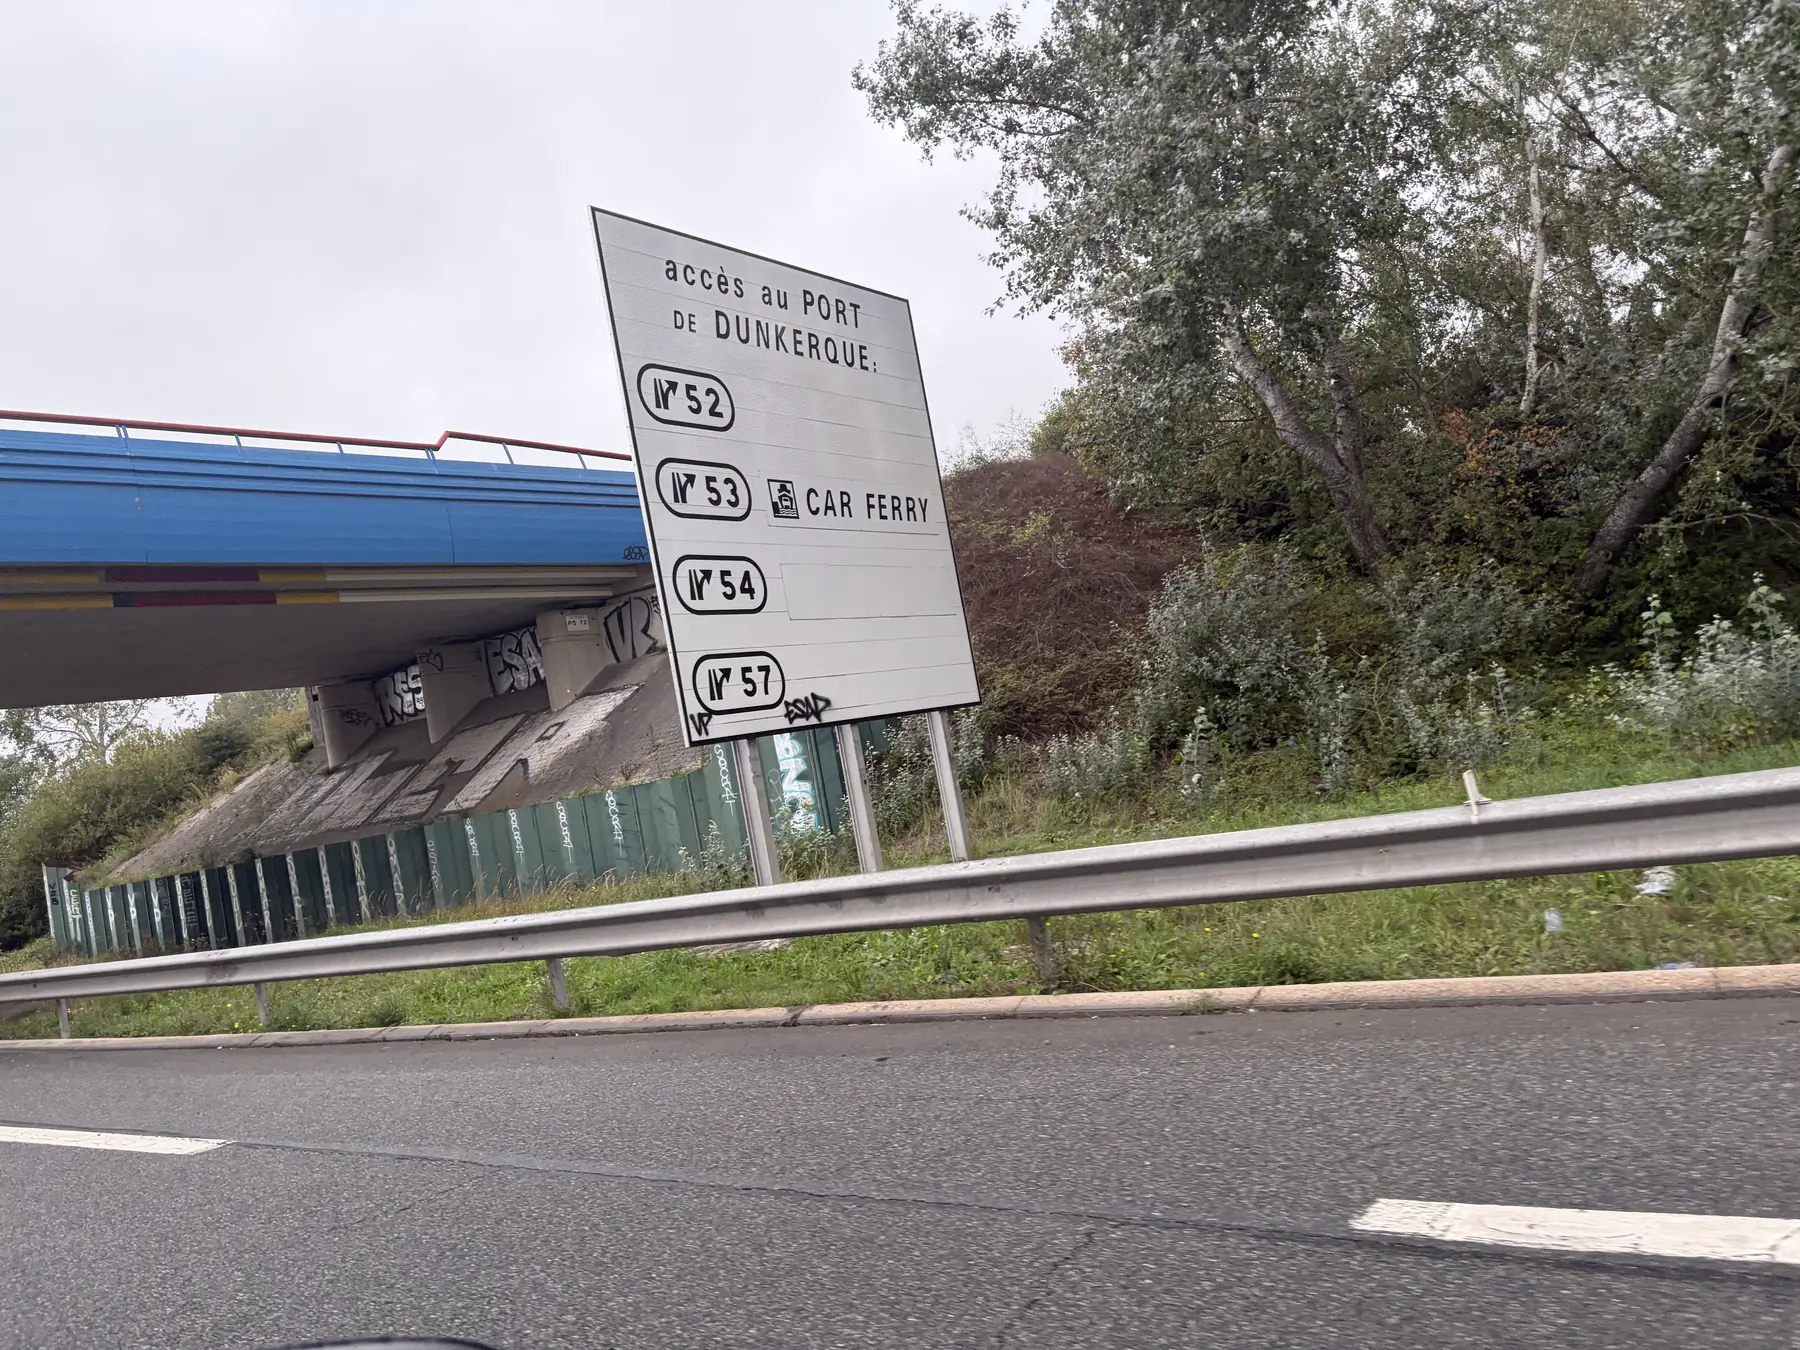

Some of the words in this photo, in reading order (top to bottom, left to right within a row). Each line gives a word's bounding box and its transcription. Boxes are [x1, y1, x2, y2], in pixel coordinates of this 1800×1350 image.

[665, 258, 744, 299] accès
[761, 284, 788, 310] au
[803, 289, 860, 329] PORT
[673, 309, 697, 333] DE
[715, 309, 878, 373] DUNKERQUE:
[685, 384, 724, 419] 52
[705, 476, 740, 508] 53
[806, 487, 853, 519] CAR
[866, 493, 929, 523] FERRY
[721, 569, 756, 601] 54
[741, 665, 771, 698] 57
